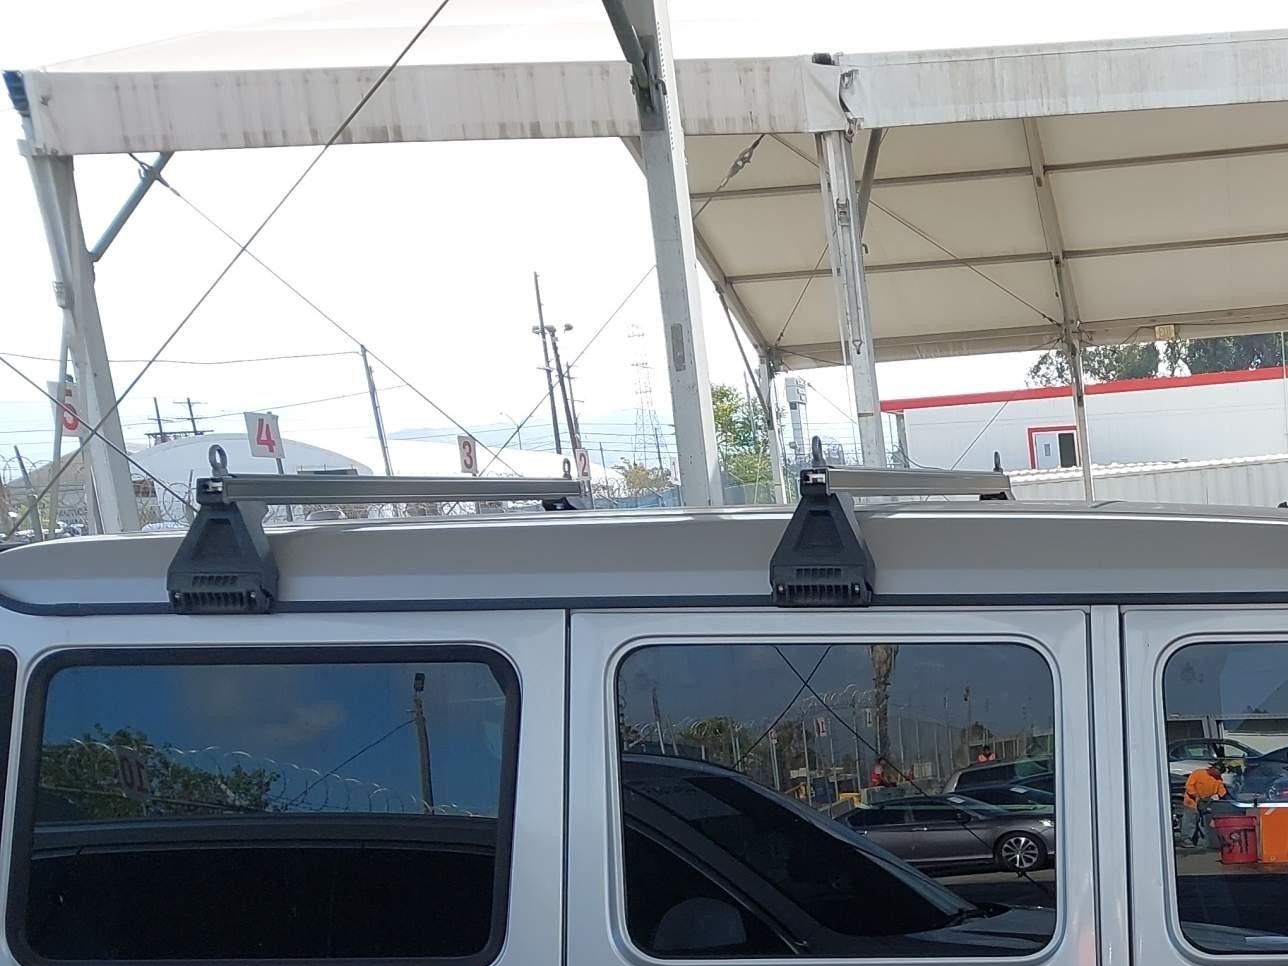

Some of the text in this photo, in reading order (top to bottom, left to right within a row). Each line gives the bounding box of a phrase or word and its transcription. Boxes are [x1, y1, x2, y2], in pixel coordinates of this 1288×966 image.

[256, 418, 276, 453] 4
[463, 440, 473, 469] 3
[579, 452, 589, 477] 2
